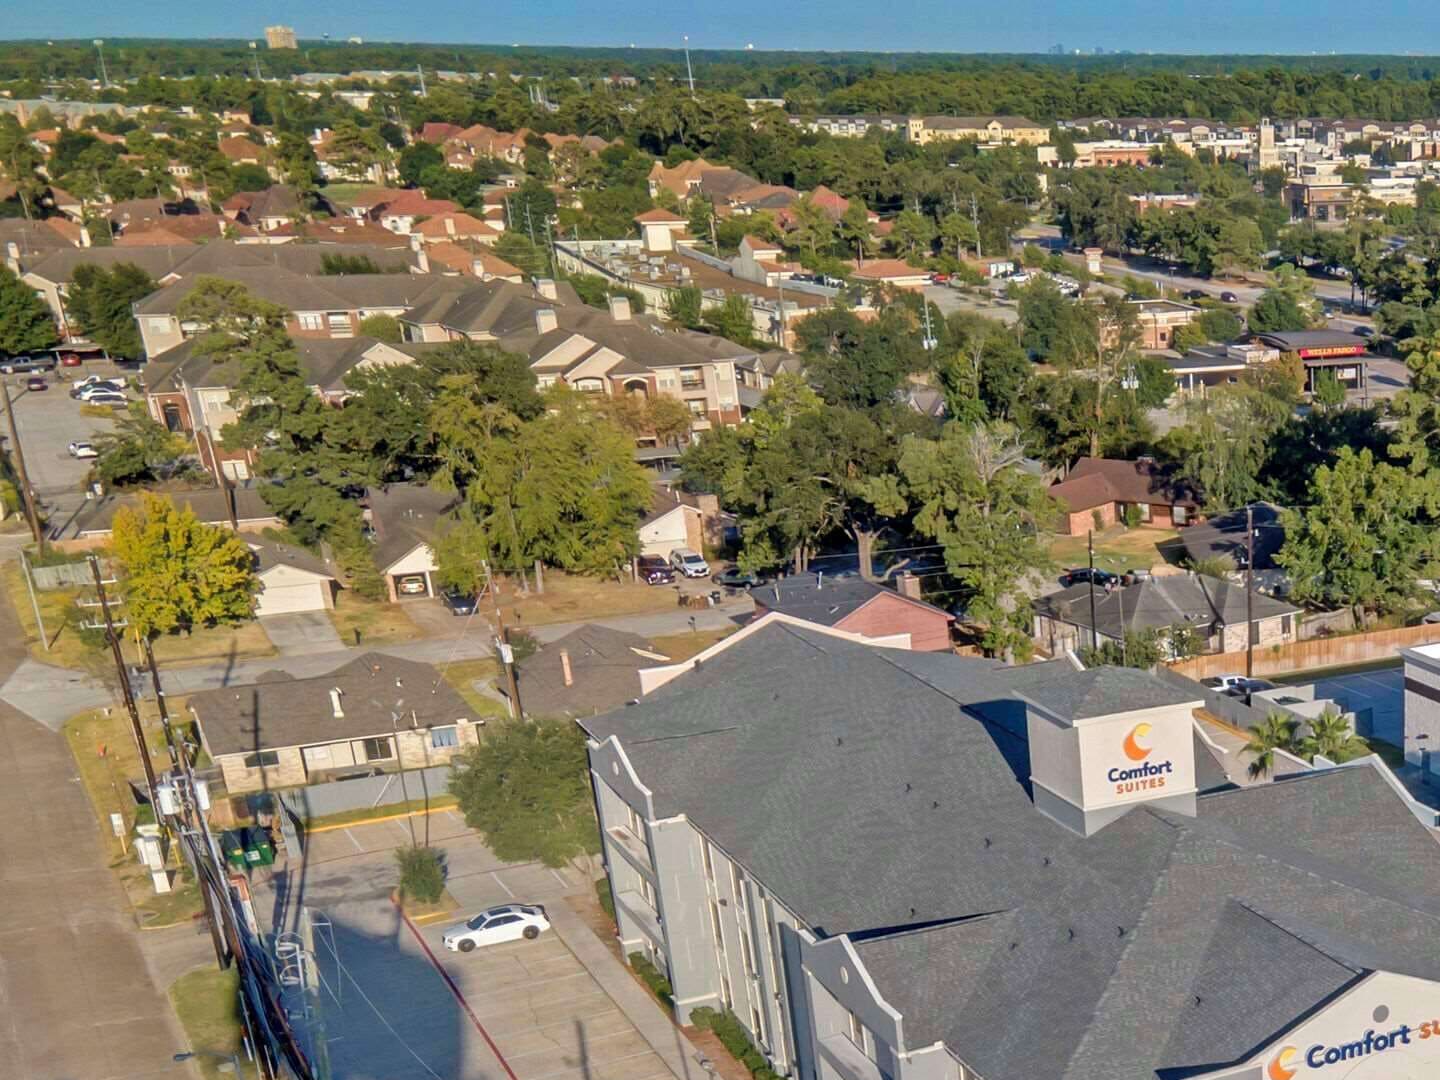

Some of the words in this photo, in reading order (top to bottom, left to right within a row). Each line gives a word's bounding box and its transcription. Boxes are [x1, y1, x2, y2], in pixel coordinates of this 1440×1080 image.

[1108, 760, 1173, 782] Comfort
[1116, 777, 1165, 794] SUITES
[1307, 1025, 1411, 1068] Comfort
